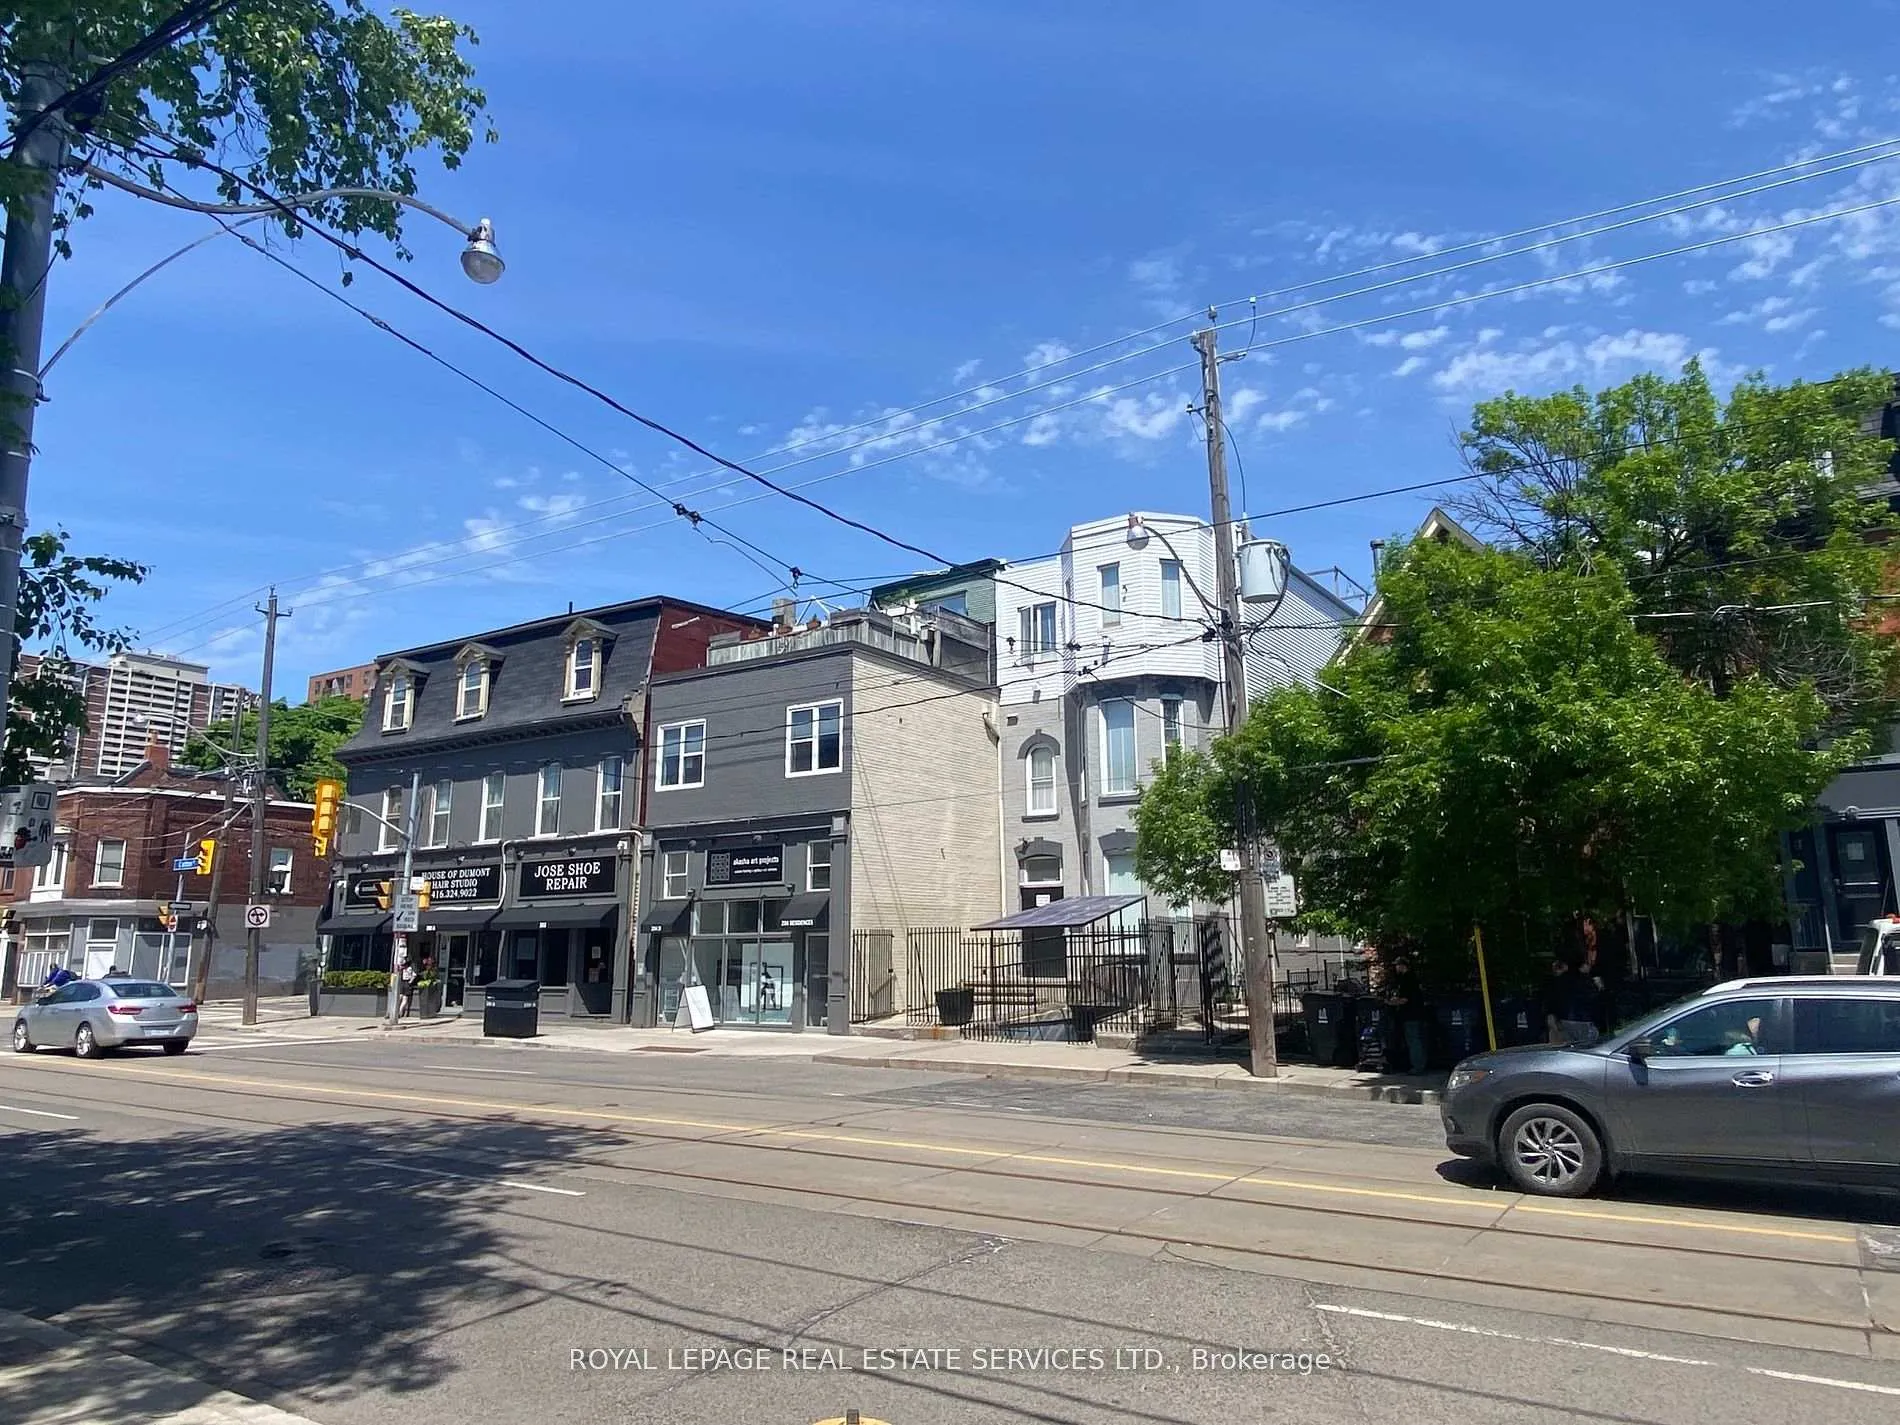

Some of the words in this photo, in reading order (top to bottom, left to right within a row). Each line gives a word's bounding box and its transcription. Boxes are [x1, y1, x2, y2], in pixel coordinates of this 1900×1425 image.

[421, 870, 446, 880] HOUSE
[447, 869, 457, 879] OF
[459, 868, 491, 878] DUMONT
[534, 864, 565, 878] JOSE
[567, 862, 601, 876] SHOE
[432, 880, 450, 889] HAIR
[450, 878, 478, 889] STUDIO
[546, 876, 588, 891] REPAIR
